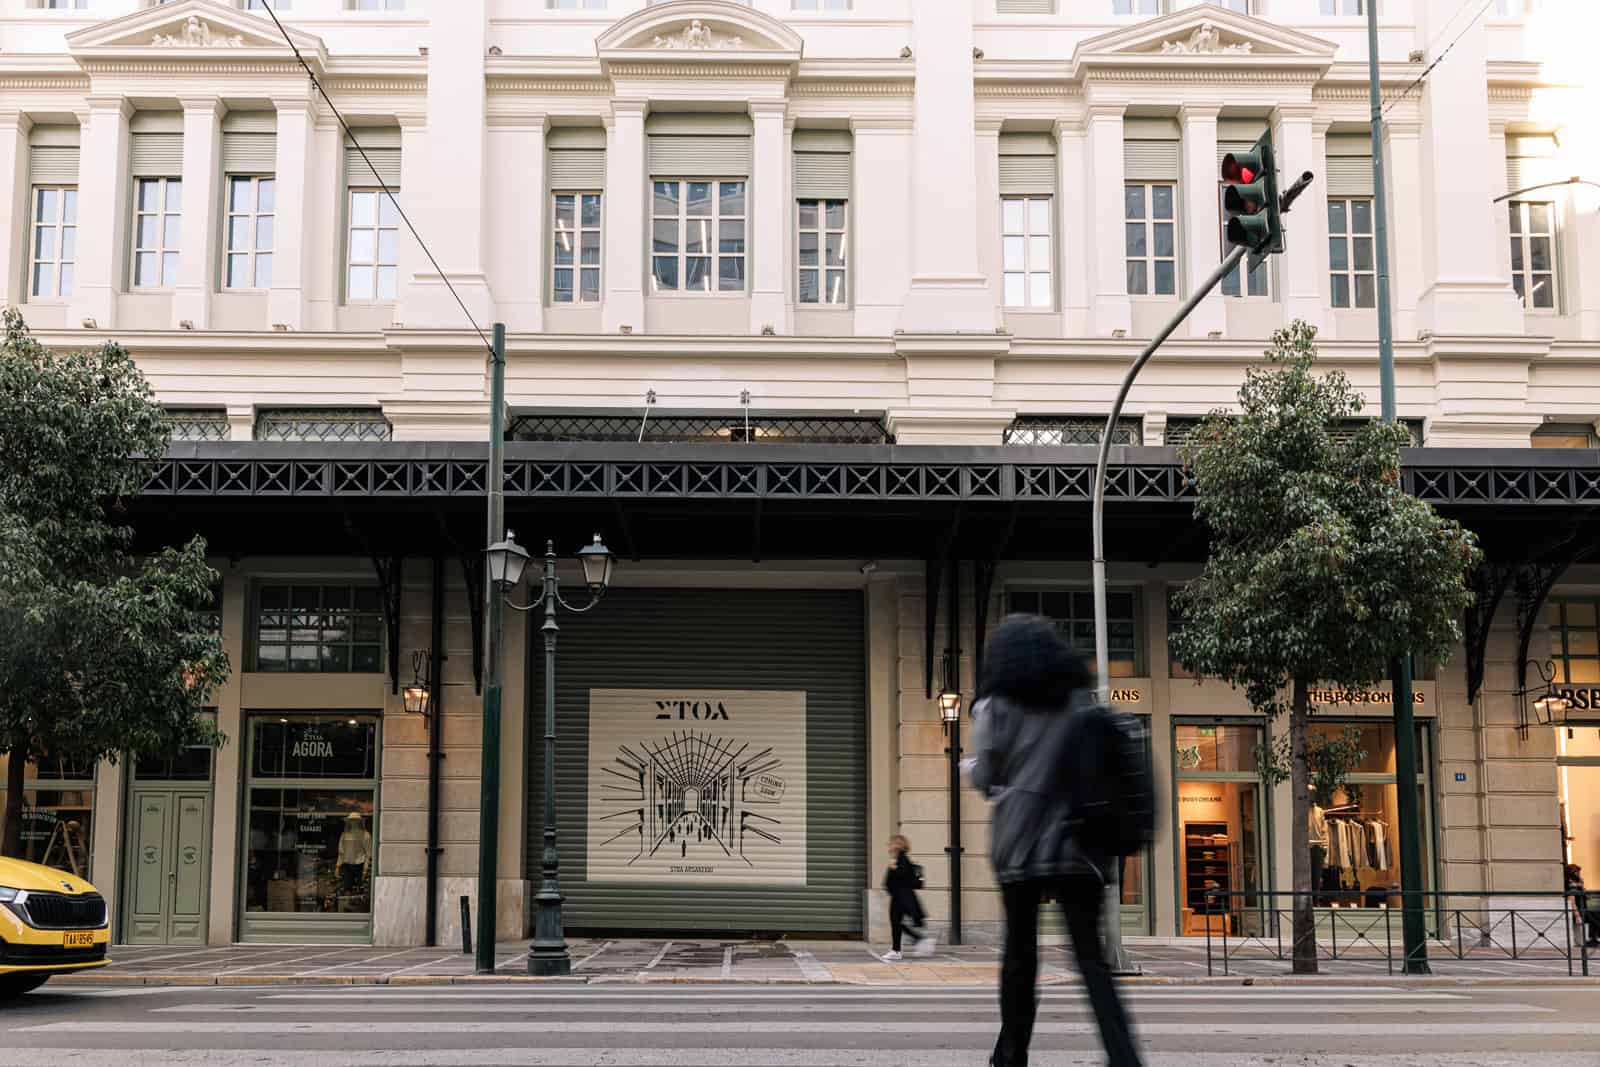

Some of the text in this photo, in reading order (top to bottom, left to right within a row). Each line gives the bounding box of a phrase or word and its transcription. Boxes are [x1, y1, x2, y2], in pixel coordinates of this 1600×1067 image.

[1111, 689, 1140, 701] ANS
[1308, 690, 1424, 703] THE BOSTONS
[292, 741, 334, 757] AGORA
[760, 775, 783, 788] COMING
